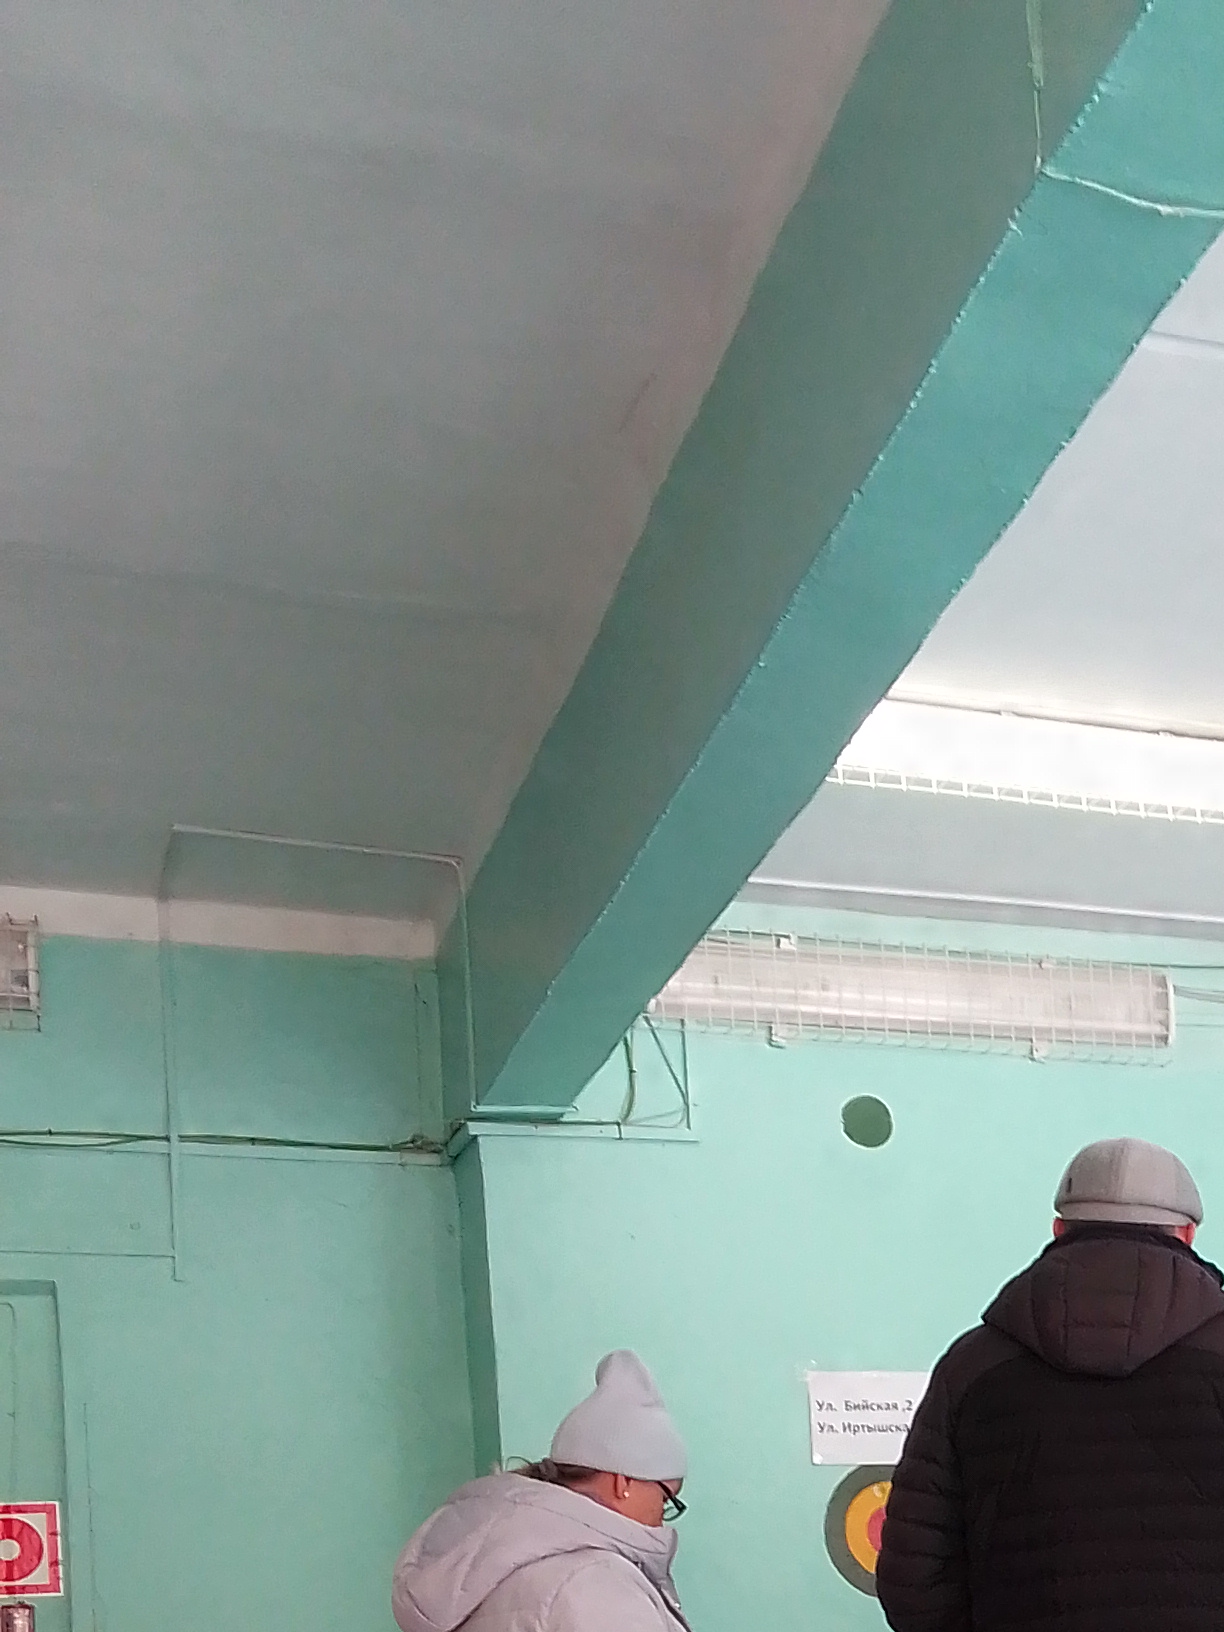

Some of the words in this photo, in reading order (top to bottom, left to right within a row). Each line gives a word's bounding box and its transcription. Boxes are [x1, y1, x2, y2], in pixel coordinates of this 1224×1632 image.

[816, 1400, 837, 1412] Ул.
[817, 1422, 839, 1433] Ул.
[842, 1422, 912, 1436] Иртышска
